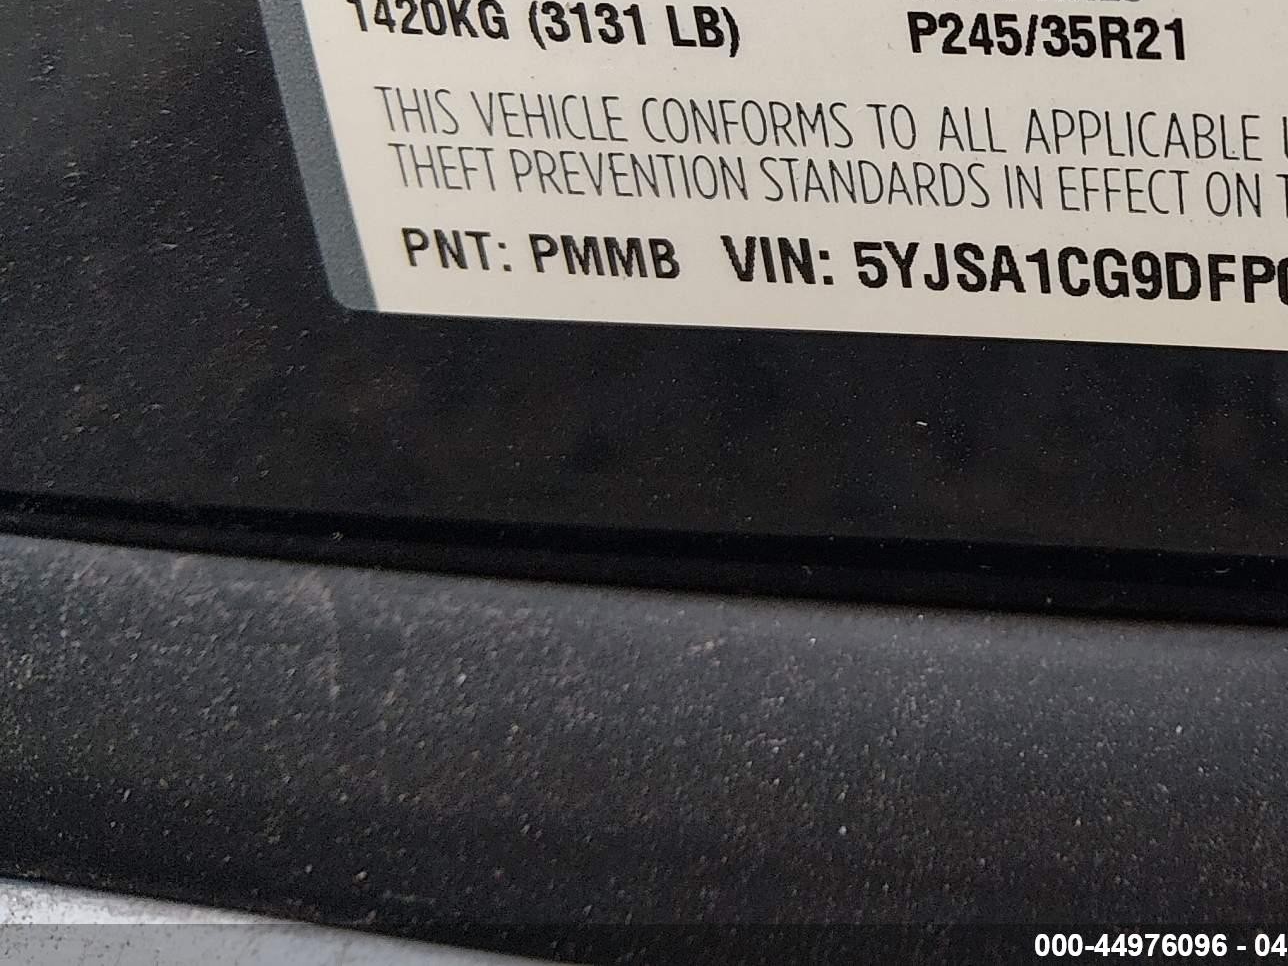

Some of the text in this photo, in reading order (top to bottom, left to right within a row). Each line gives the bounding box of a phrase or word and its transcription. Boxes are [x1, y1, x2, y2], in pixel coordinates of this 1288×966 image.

[527, 0, 647, 51] (3131
[665, 4, 741, 59] LB)
[906, 10, 1186, 61] P245/35R21
[373, 85, 460, 135] THIS
[469, 90, 629, 143] VEHICLE
[641, 97, 854, 149] CONFORMS
[865, 103, 917, 151] TO
[938, 105, 1008, 154] ALL
[1025, 108, 1263, 162] APPLICABLE
[387, 142, 496, 192] THEFT
[508, 148, 749, 201] PREVENTION
[759, 156, 991, 209] STANDARDS
[1003, 164, 1044, 210] IN
[1057, 165, 1190, 216] EFFECT
[1205, 170, 1262, 218] ON
[401, 227, 513, 273] PNT:
[528, 233, 681, 280] PMMB
[719, 234, 835, 286] VIN:
